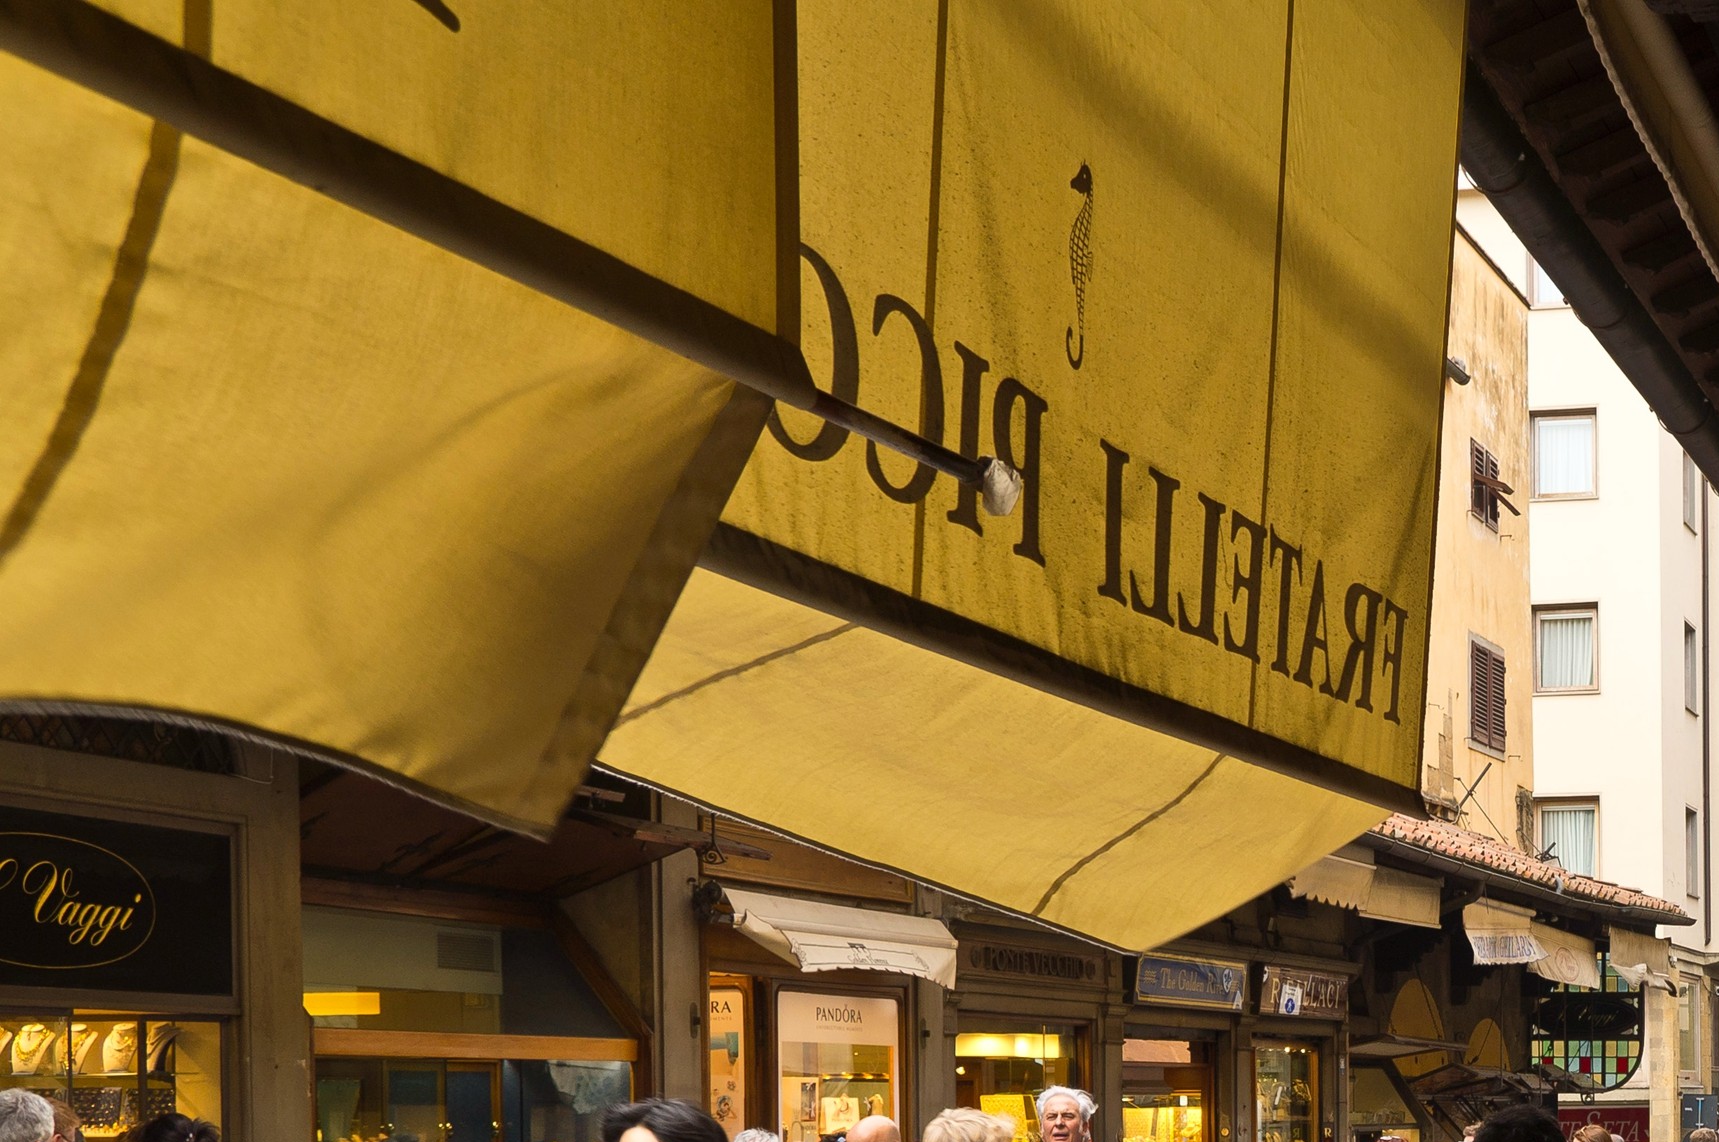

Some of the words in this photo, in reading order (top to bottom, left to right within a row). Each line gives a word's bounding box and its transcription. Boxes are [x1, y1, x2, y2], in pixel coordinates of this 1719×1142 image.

[22, 860, 142, 946] Vaggi
[1032, 951, 1086, 979] VECCHIO
[1160, 967, 1176, 990] The
[1178, 969, 1204, 992] Golden
[1206, 973, 1225, 995] Rive
[816, 1004, 863, 1024] PANDORA
